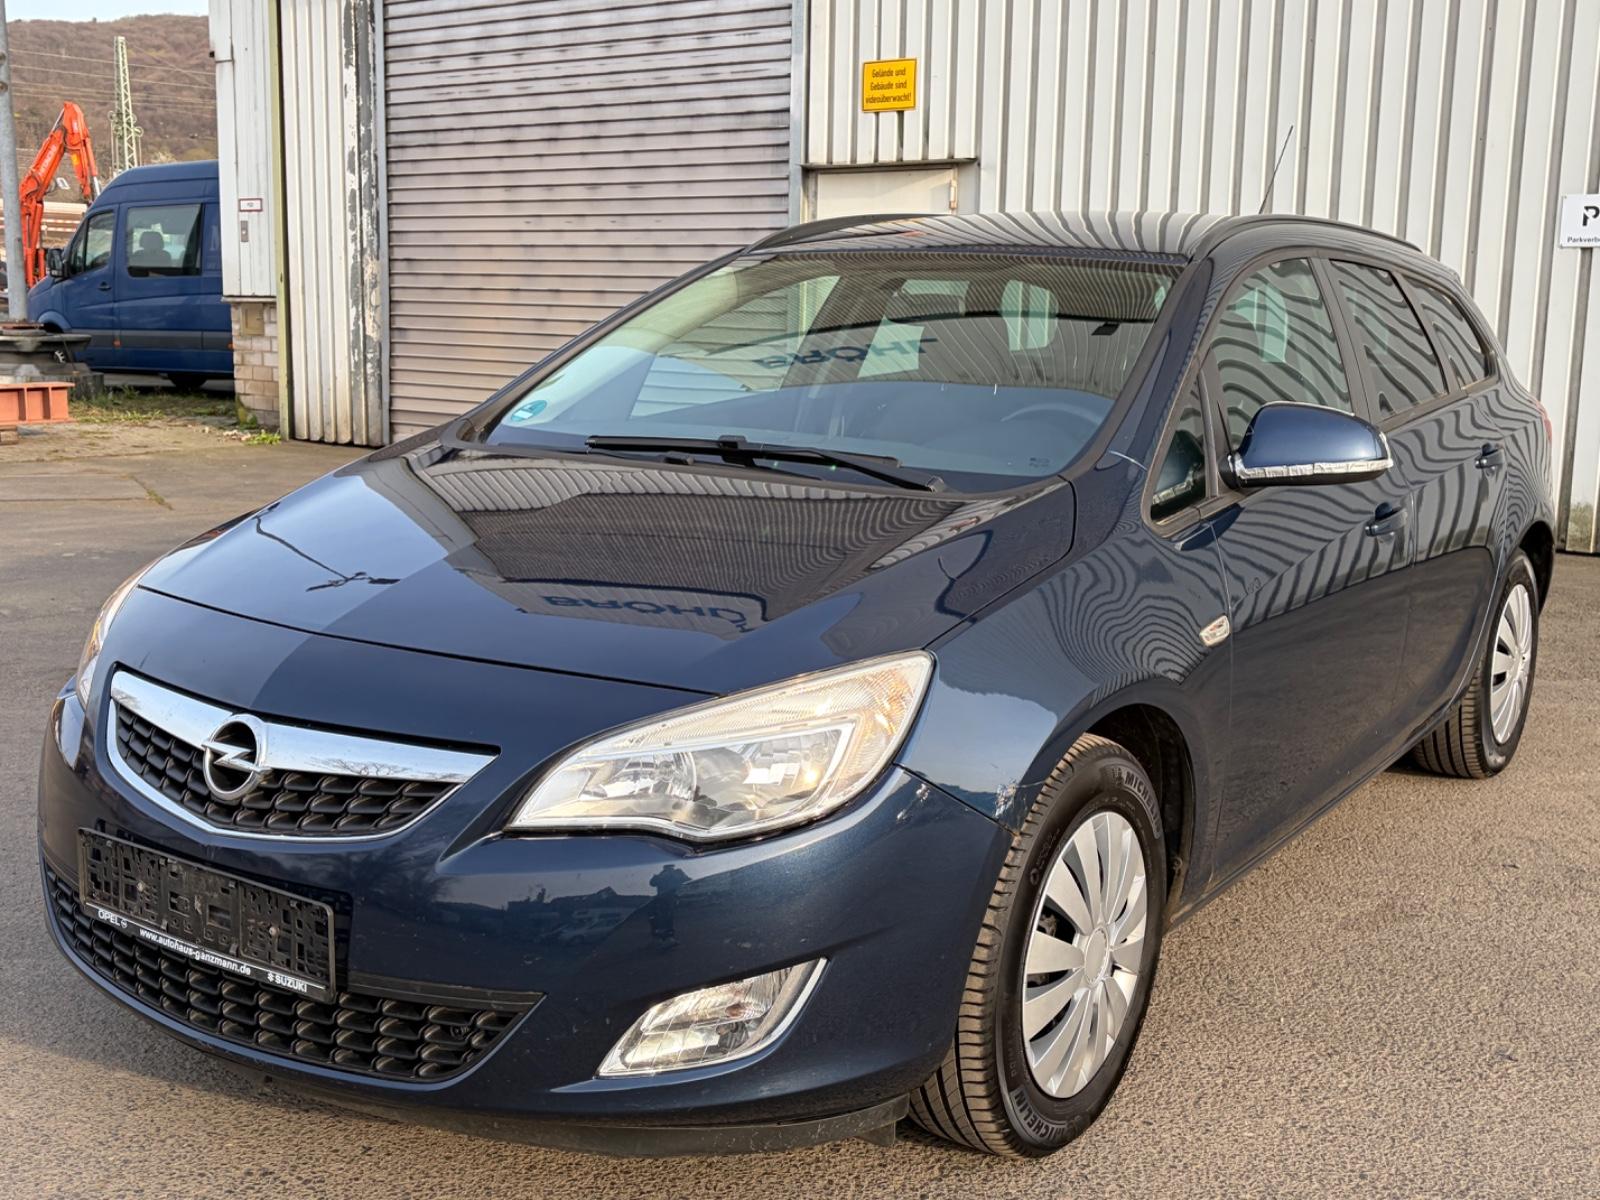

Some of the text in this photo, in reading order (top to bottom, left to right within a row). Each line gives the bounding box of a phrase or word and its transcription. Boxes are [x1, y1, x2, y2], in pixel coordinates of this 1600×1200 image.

[895, 67, 906, 76] und
[98, 909, 121, 927] OPEL
[139, 927, 251, 976] www.autohaus-ganzmann.de
[275, 974, 308, 993] SUZUKI
